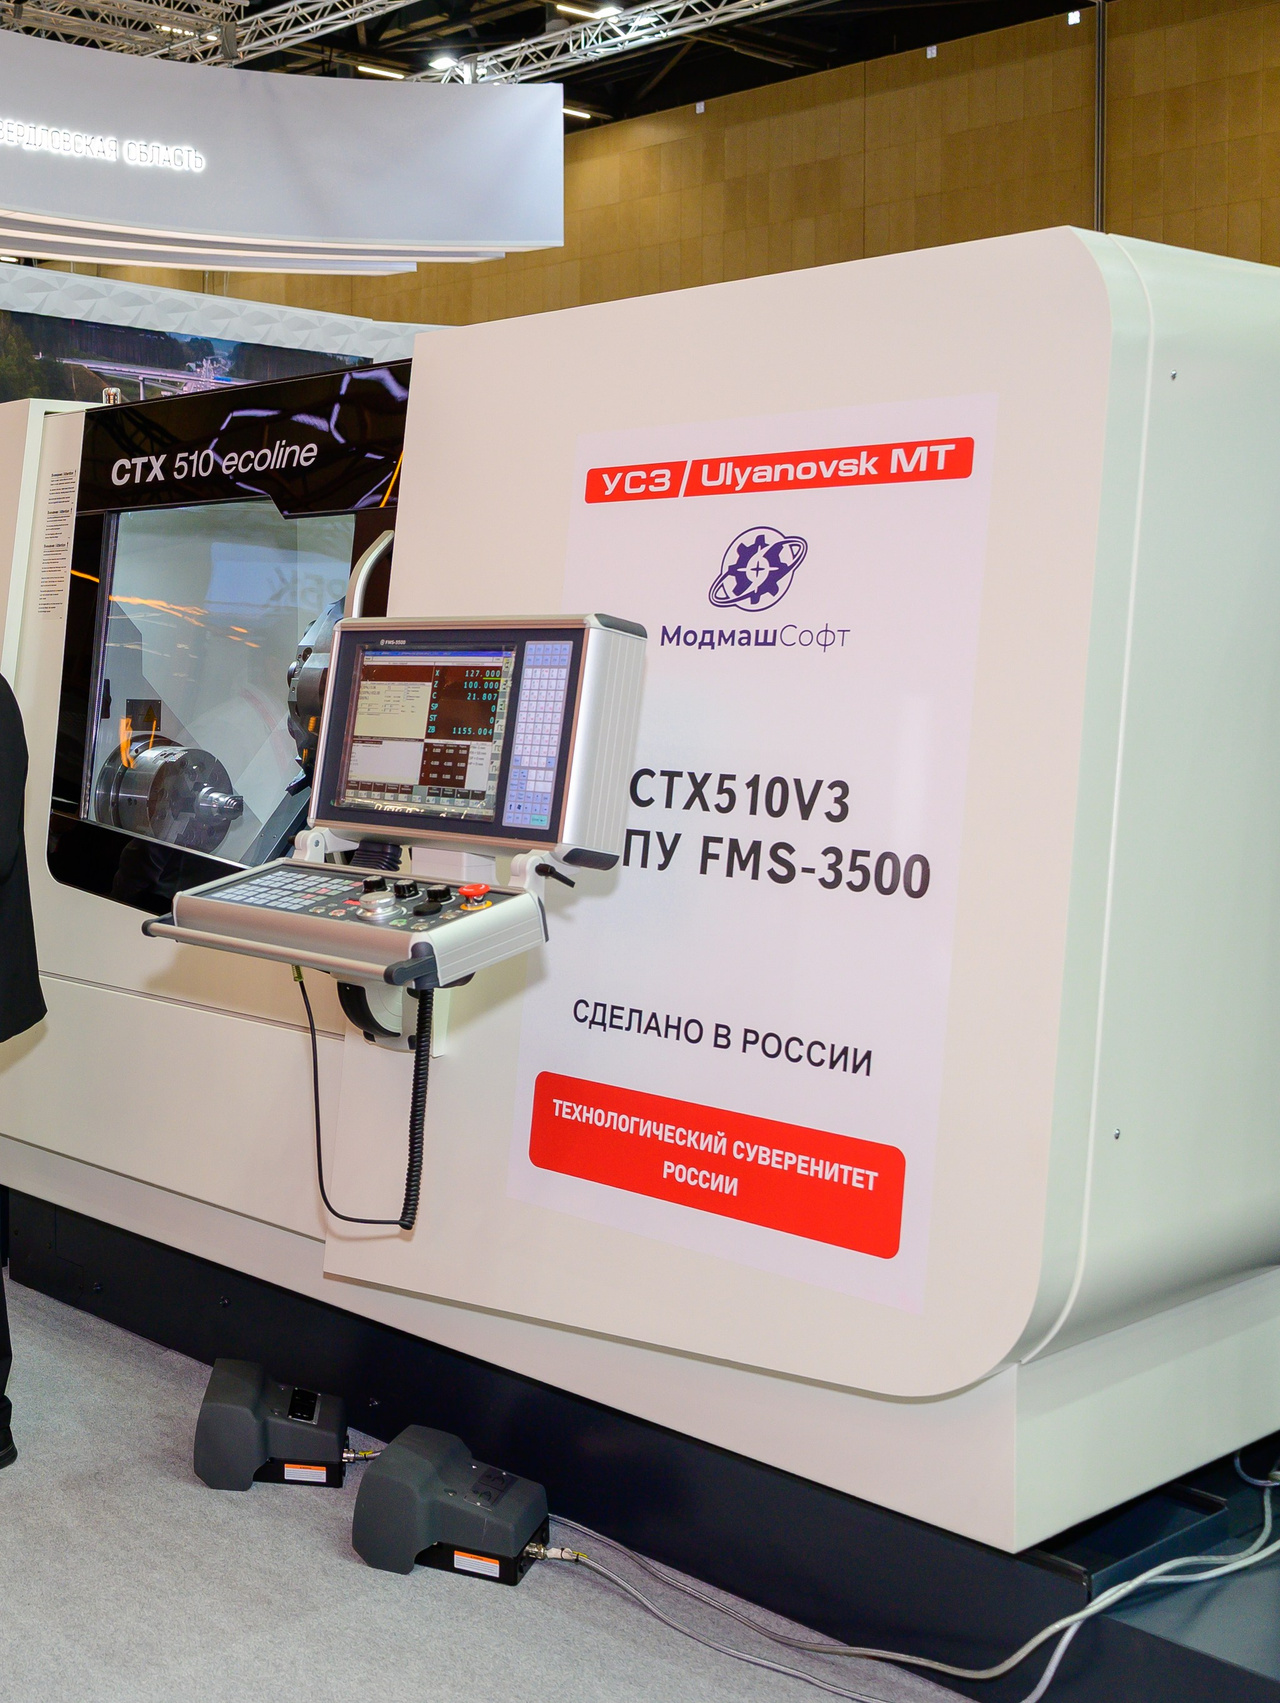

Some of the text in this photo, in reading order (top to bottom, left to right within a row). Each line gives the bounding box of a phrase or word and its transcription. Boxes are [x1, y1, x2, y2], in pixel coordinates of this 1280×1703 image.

[125, 140, 204, 172] ОБЛАСТЬ
[111, 439, 318, 486] CTX 510 ecoline
[701, 451, 878, 491] Ulyanovsk
[890, 444, 956, 473] MT
[660, 623, 851, 653] МодмашСофт
[463, 681, 499, 689] 100.000
[465, 669, 501, 678] 127.000
[466, 692, 498, 701] 21.807
[491, 705, 496, 713] 0
[452, 726, 493, 736] 1155.004
[489, 717, 494, 725] 0
[628, 767, 851, 824] CTX510V3
[699, 835, 931, 899] FMS-3500
[572, 998, 873, 1077] СДЕЛАНО В РОССИИ
[552, 1098, 879, 1191] ТЕХНОЛОГИЧЕСКИЙ СУВЕРЕНИТЕТ
[662, 1159, 739, 1197] РОССИИ
